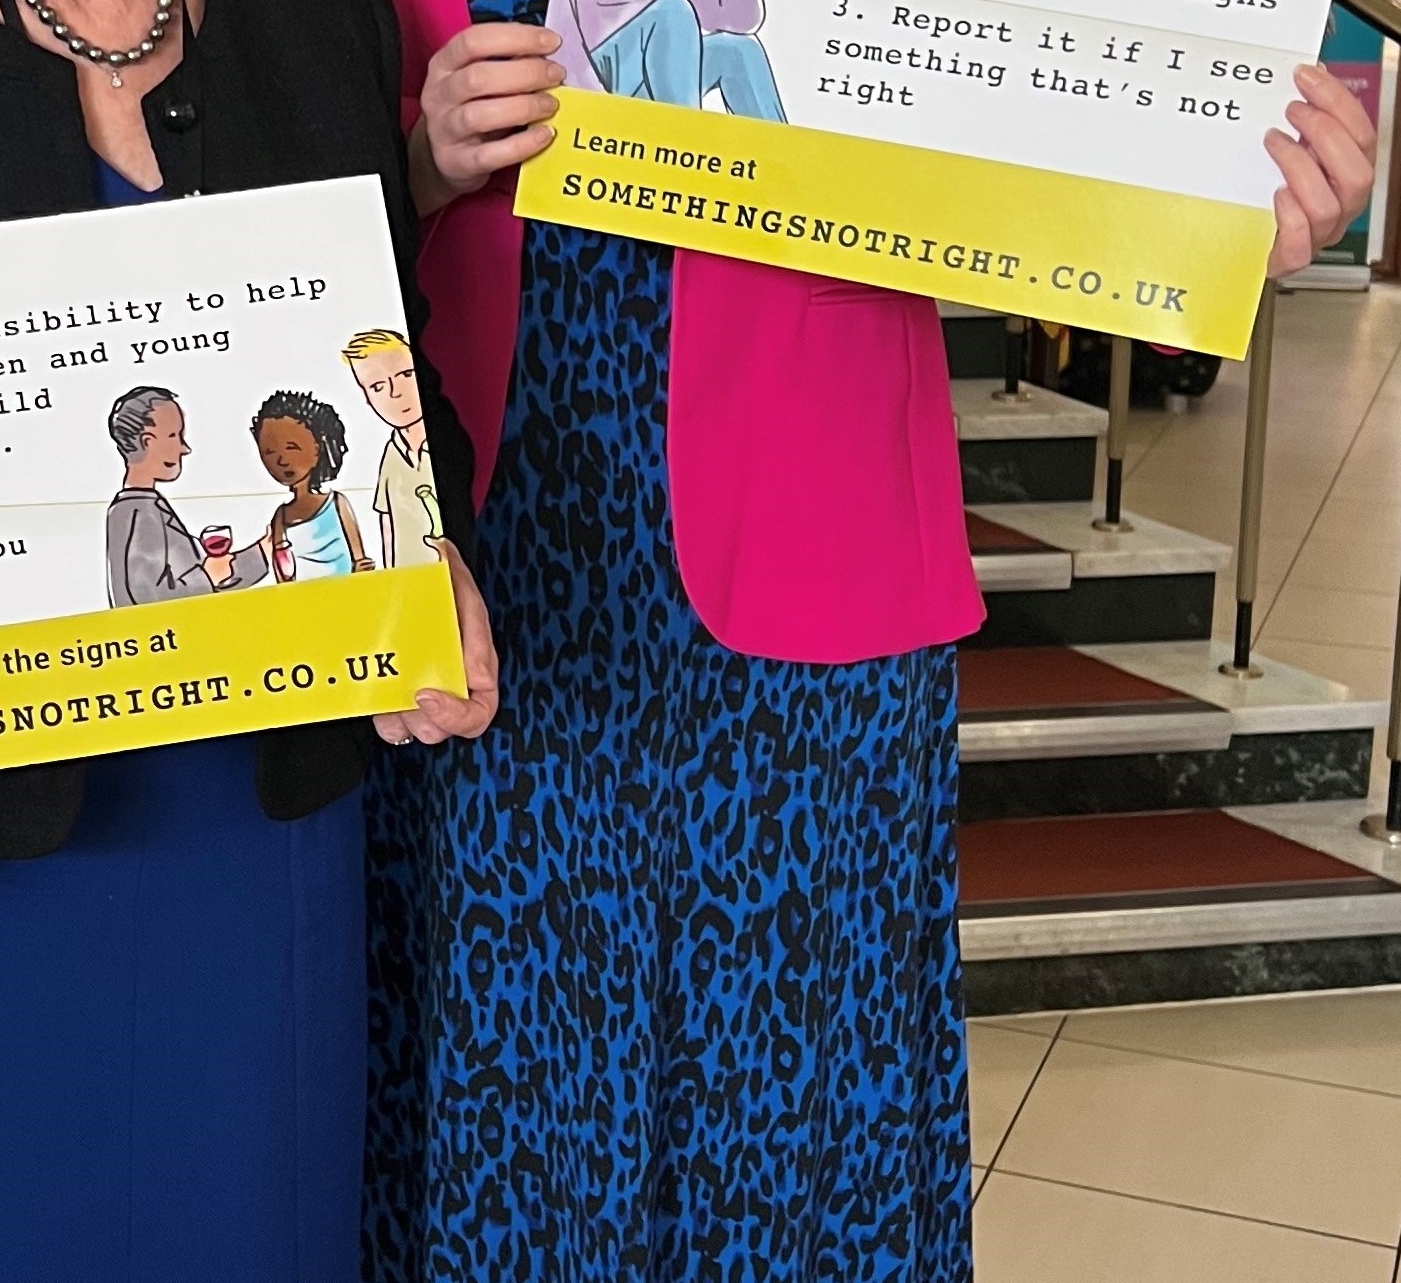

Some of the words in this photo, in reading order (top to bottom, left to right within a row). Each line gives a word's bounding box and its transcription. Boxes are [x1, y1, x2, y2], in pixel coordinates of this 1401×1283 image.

[891, 5, 1013, 43] Report
[1037, 26, 1076, 53] it
[1101, 36, 1144, 64] if
[1166, 48, 1186, 71] I
[1209, 60, 1274, 85] see
[816, 73, 914, 107] right
[824, 38, 1007, 87] something
[1177, 96, 1241, 121] not
[572, 127, 646, 161] Learn
[654, 146, 722, 174] more
[730, 159, 758, 181] at
[562, 173, 1188, 314] SOMETHINGSNOTRIGHT.CO.UK
[185, 292, 225, 312] to
[245, 276, 327, 304] help
[50, 341, 109, 370] and
[129, 330, 230, 365] young
[1, 647, 51, 675] the
[60, 638, 139, 669] signs
[149, 628, 178, 653] at
